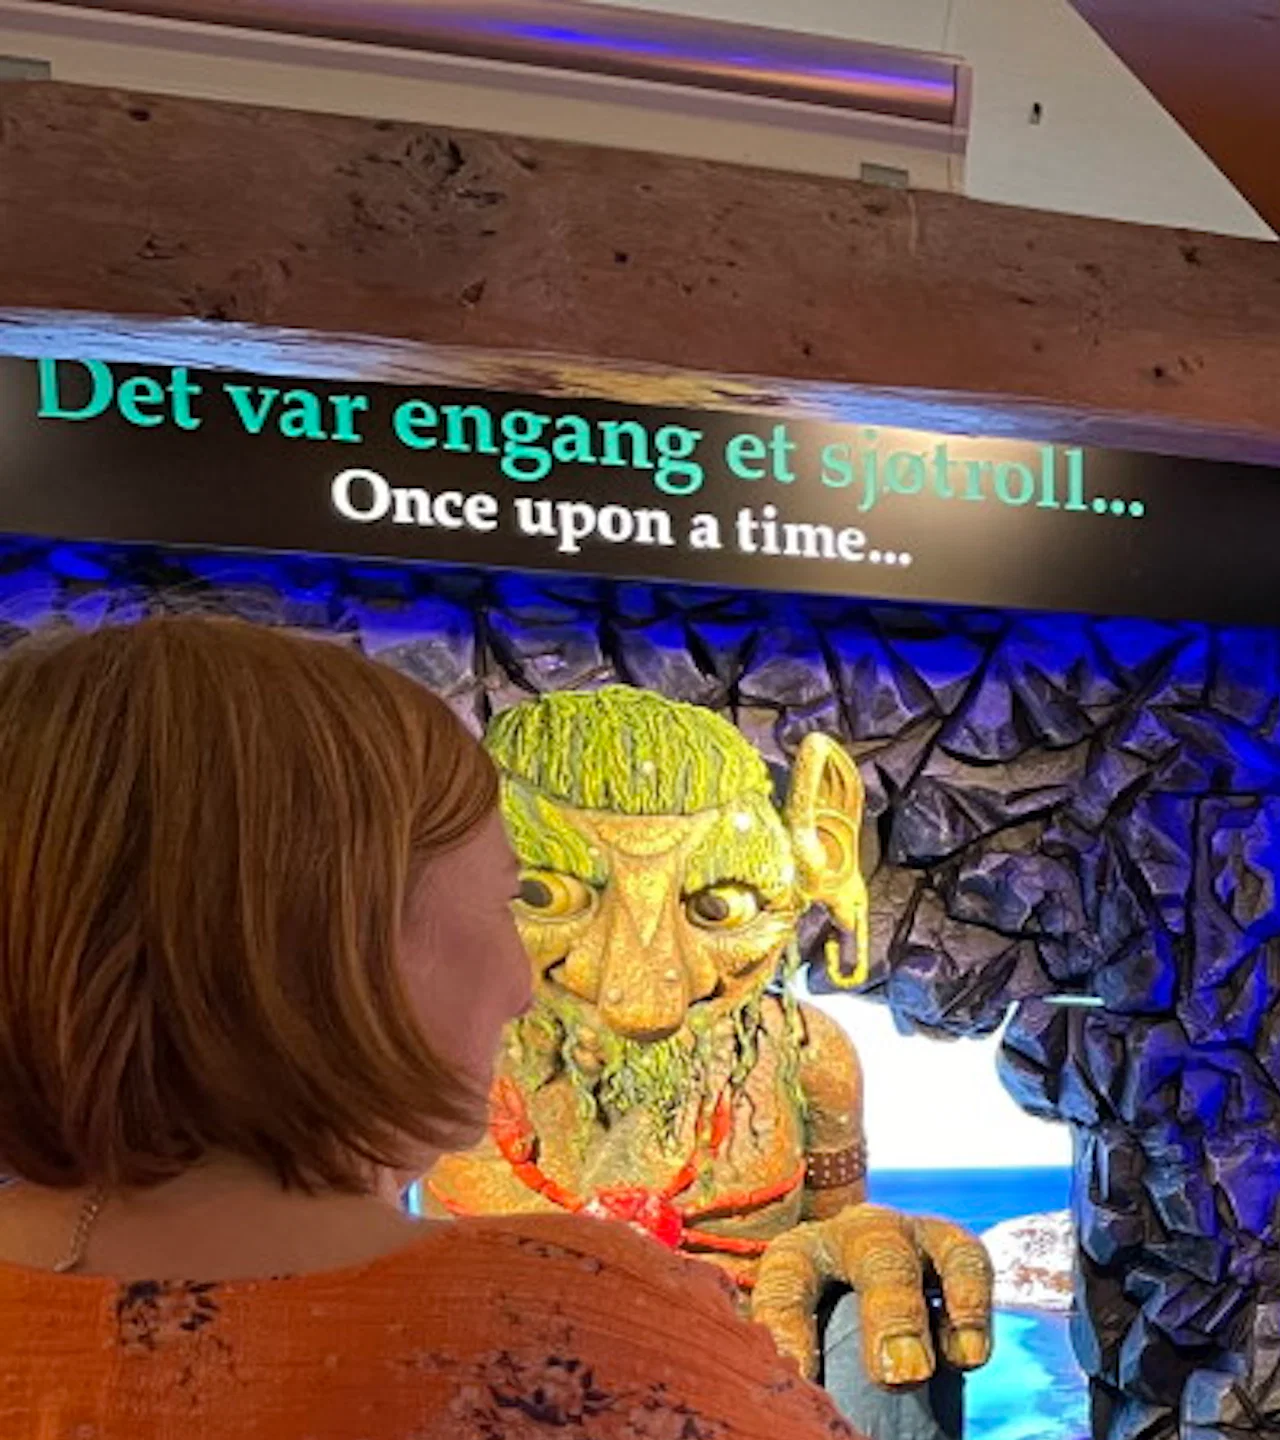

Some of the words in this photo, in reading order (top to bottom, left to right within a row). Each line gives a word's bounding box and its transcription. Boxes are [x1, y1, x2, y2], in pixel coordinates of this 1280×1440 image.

[36, 357, 201, 430] Det
[222, 382, 369, 443] var
[392, 399, 704, 495] engang
[725, 424, 798, 483] et
[820, 428, 1146, 517] sjøtroll...
[330, 468, 499, 532] Once
[513, 496, 675, 553] upon
[689, 513, 722, 550] a
[736, 505, 912, 566] time...
